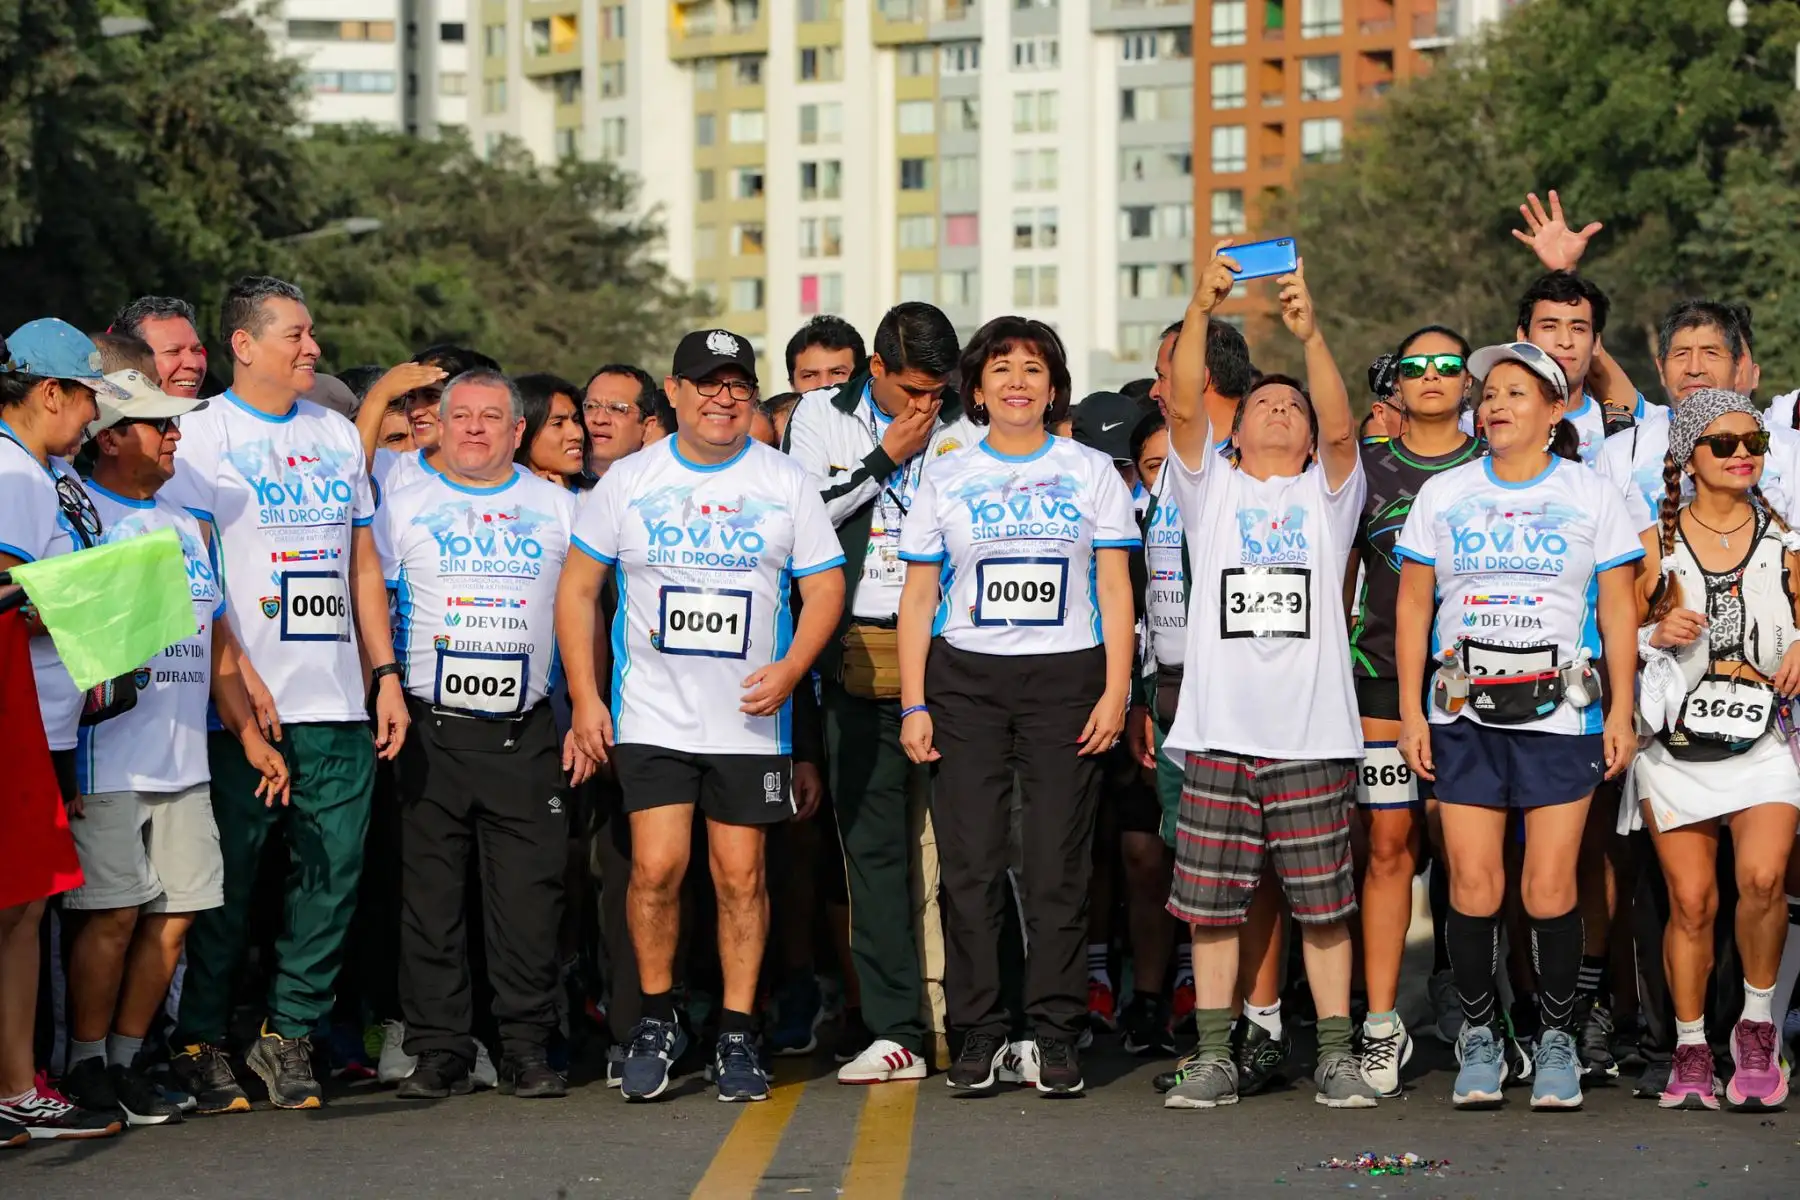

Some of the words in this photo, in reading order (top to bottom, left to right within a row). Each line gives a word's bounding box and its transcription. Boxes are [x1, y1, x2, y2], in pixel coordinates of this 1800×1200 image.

[260, 509, 285, 524] SIN
[972, 525, 999, 540] SIN
[1006, 522, 1079, 539] DROGAS
[440, 560, 466, 572] SIN
[472, 560, 540, 575] DROGAS
[647, 549, 676, 563] SIN
[682, 551, 759, 568] DROGAS
[1453, 557, 1479, 571] SIN
[1485, 556, 1564, 572] DROGAS
[987, 581, 1056, 602] 0009
[292, 595, 346, 617] 0006
[1231, 592, 1302, 614] 3239
[466, 615, 528, 630] DEVIDA
[670, 610, 737, 634] 0001
[1481, 614, 1543, 628] DEVIDA
[455, 640, 535, 654] DIRANDRO
[446, 674, 517, 697] 0002
[1691, 698, 1764, 723] 3665
